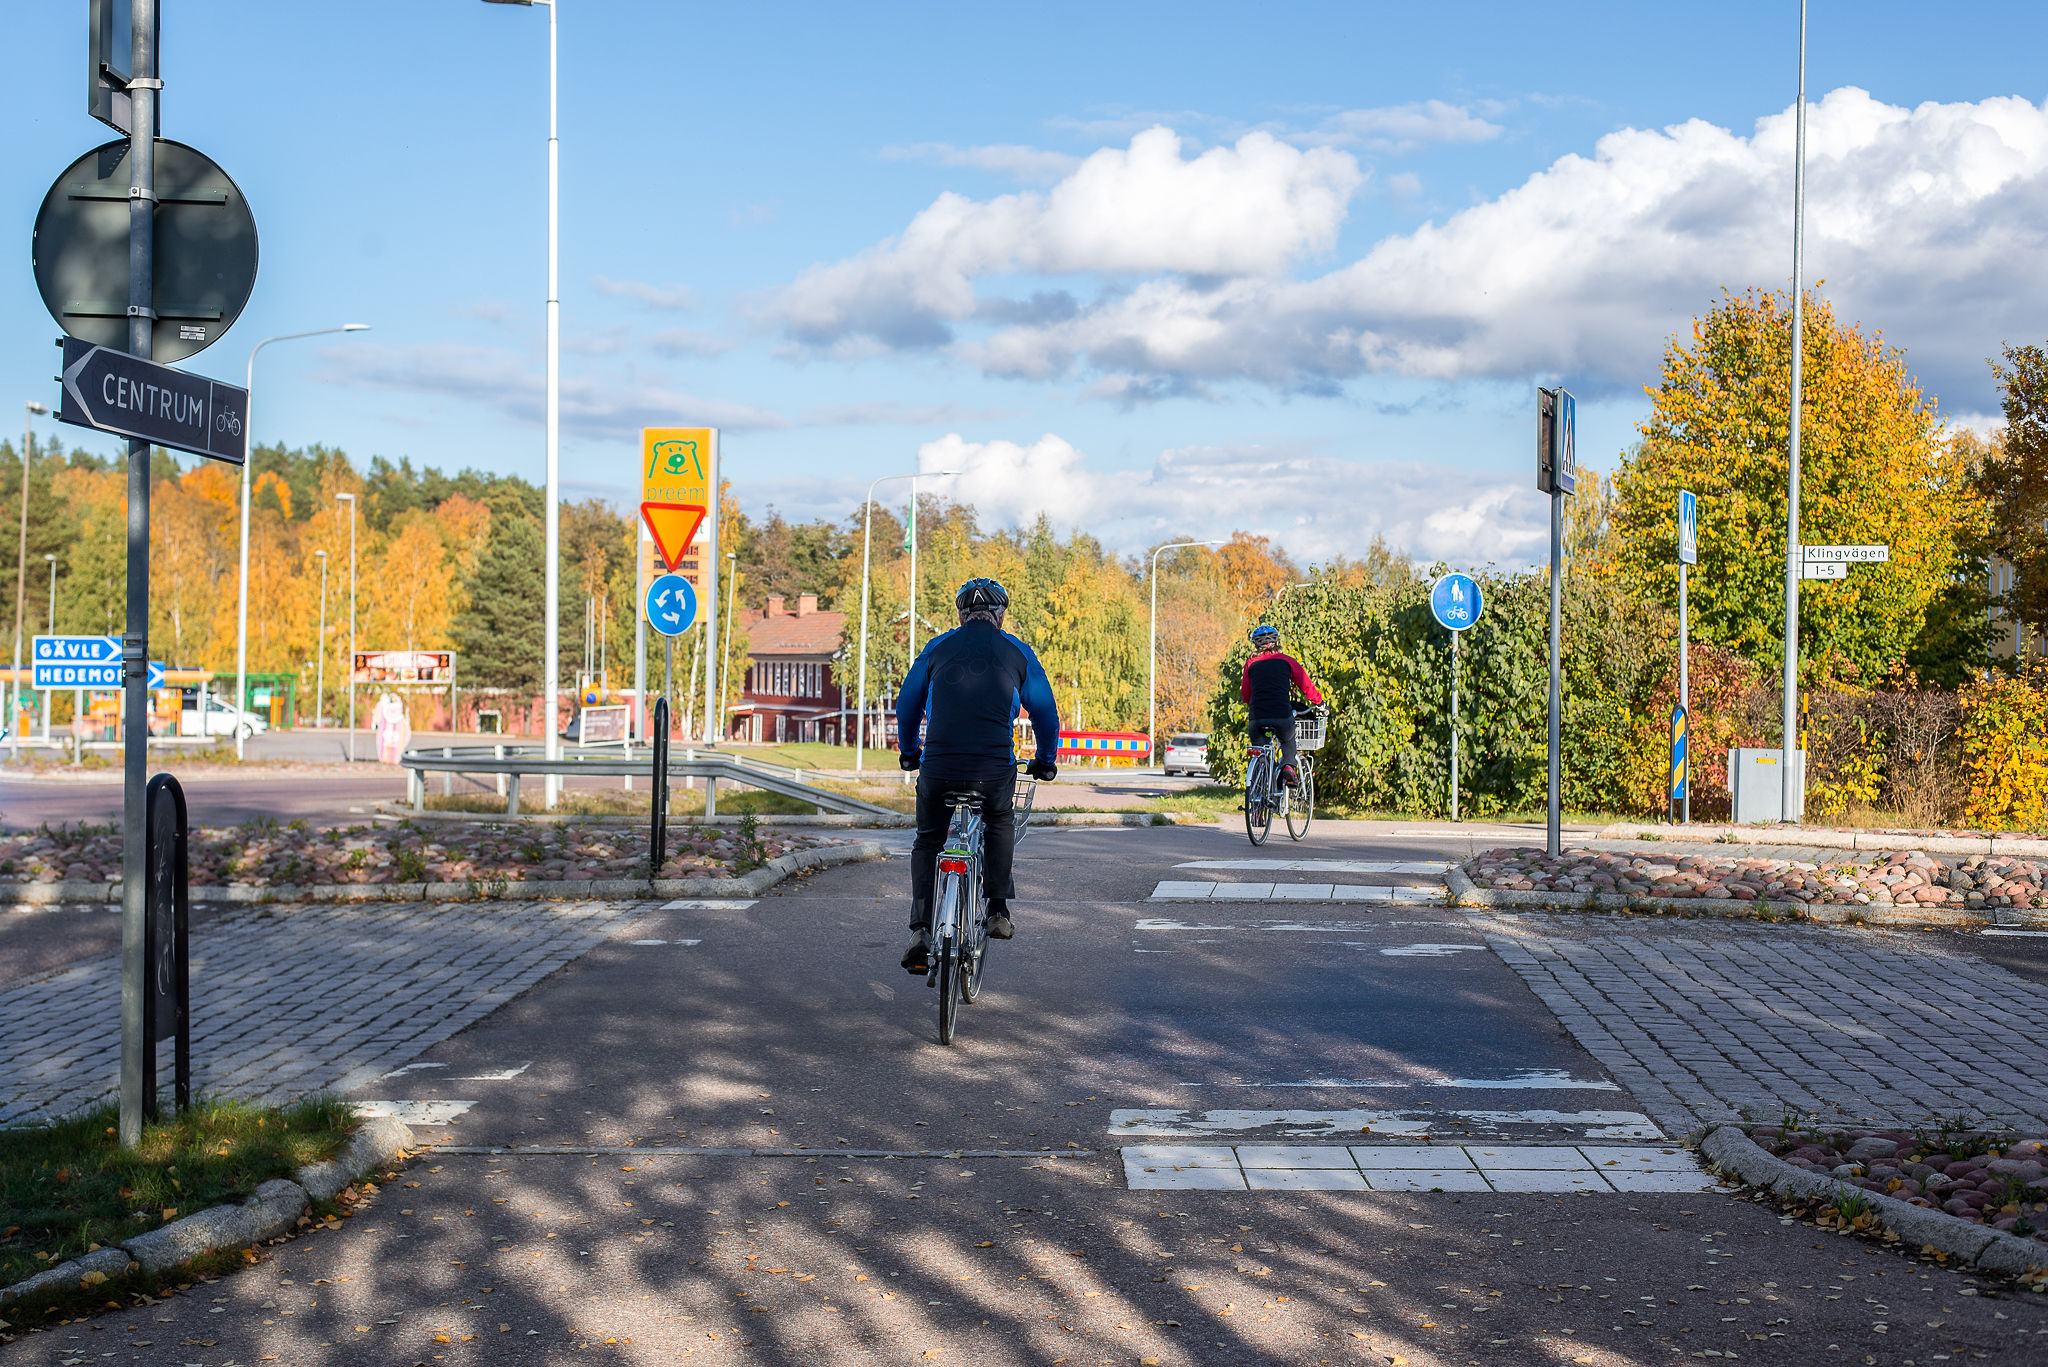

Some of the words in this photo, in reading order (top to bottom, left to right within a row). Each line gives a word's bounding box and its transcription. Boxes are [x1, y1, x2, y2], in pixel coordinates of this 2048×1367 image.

[102, 373, 203, 428] CENTRUM
[647, 487, 705, 501] preem
[1808, 548, 1885, 560] Klingvägen
[1815, 565, 1835, 575] 1-5
[39, 640, 101, 658] GÄVLE
[40, 668, 123, 683] HEDEMO
